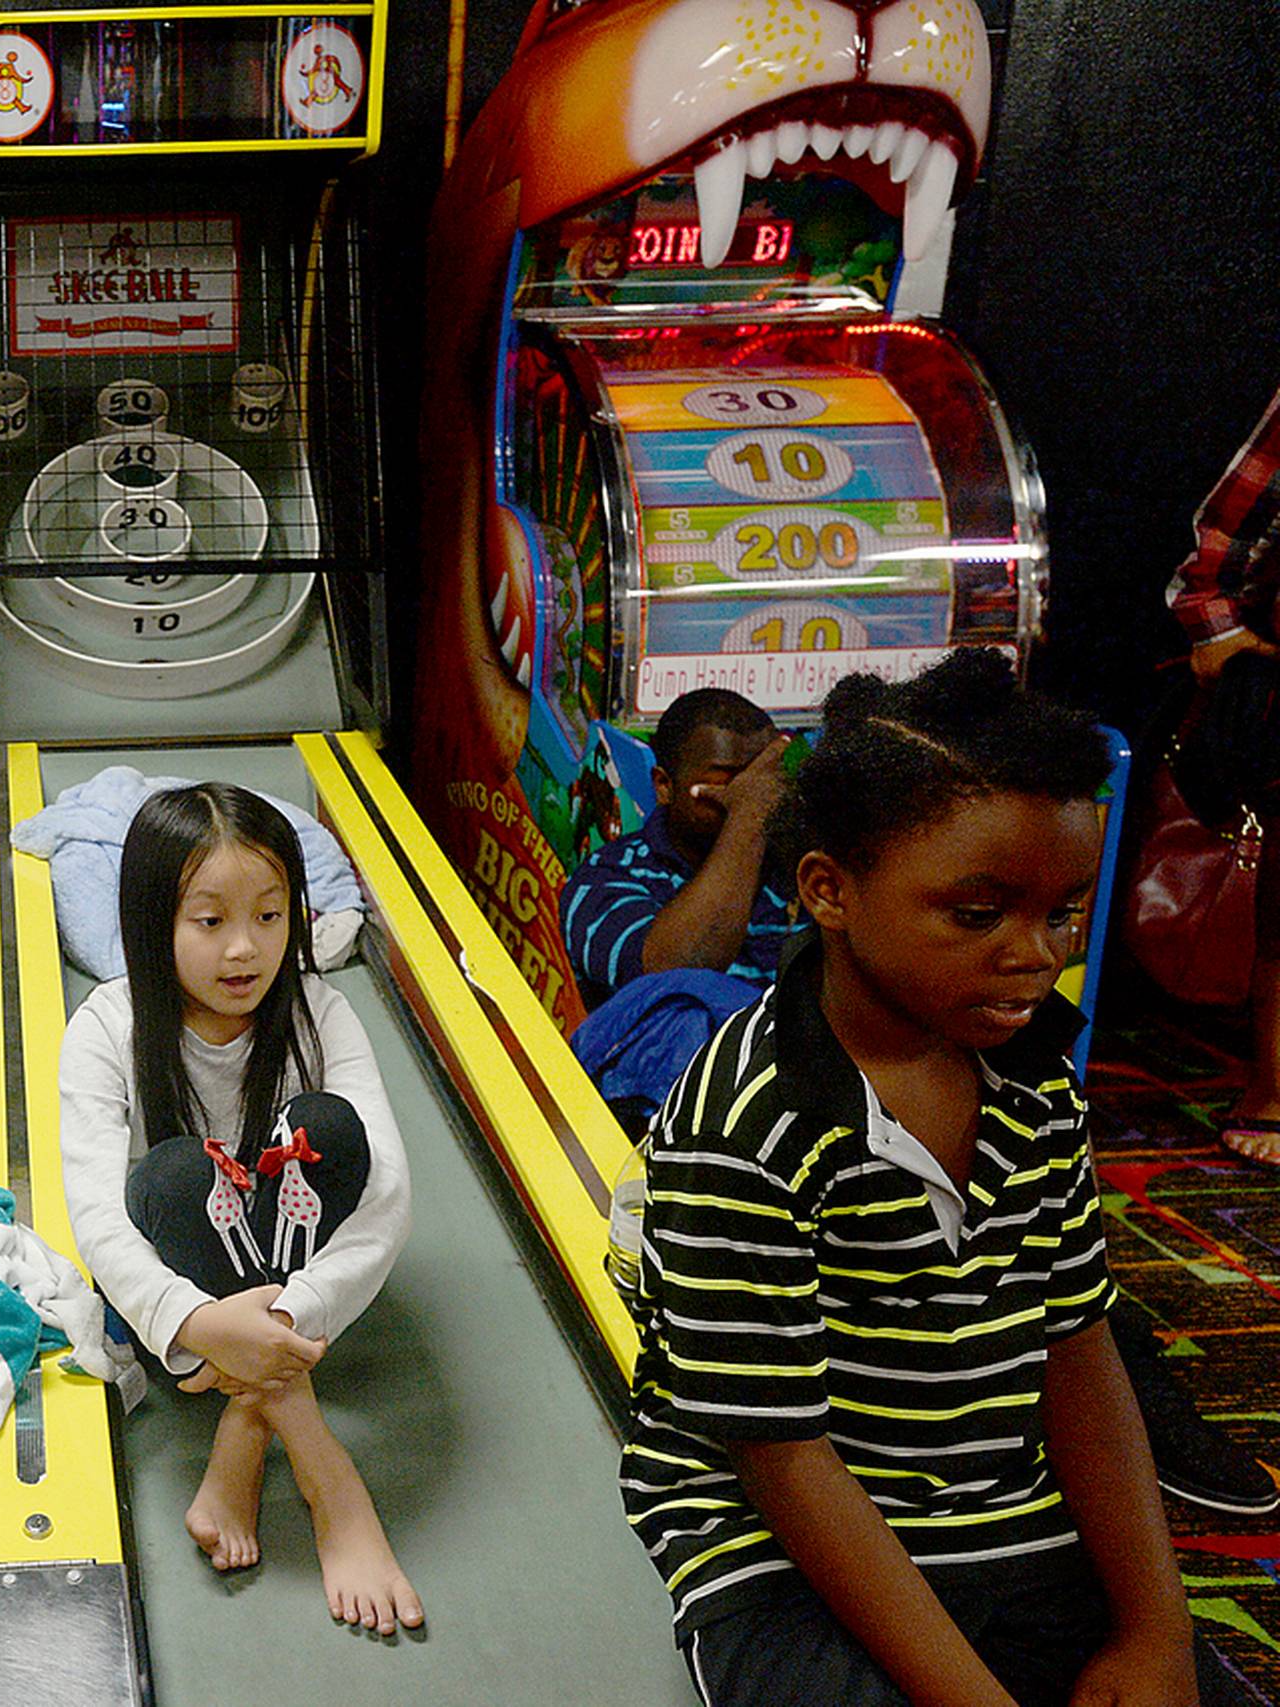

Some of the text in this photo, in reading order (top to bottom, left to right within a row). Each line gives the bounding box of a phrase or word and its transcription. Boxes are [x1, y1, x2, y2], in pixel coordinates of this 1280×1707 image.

[629, 226, 701, 262] OIN
[110, 390, 151, 412] 50
[708, 390, 798, 412] 30
[114, 445, 156, 465] 40
[732, 441, 827, 483] 10
[119, 507, 167, 528] 30
[736, 522, 859, 571] 200
[133, 613, 179, 634] 10
[750, 618, 842, 651] 10
[641, 661, 688, 697] Pump
[696, 658, 756, 695] Handle
[765, 656, 786, 693] To
[793, 655, 838, 692] Make
[491, 790, 520, 828] OF
[521, 814, 566, 889] THE
[475, 827, 539, 923] BIG
